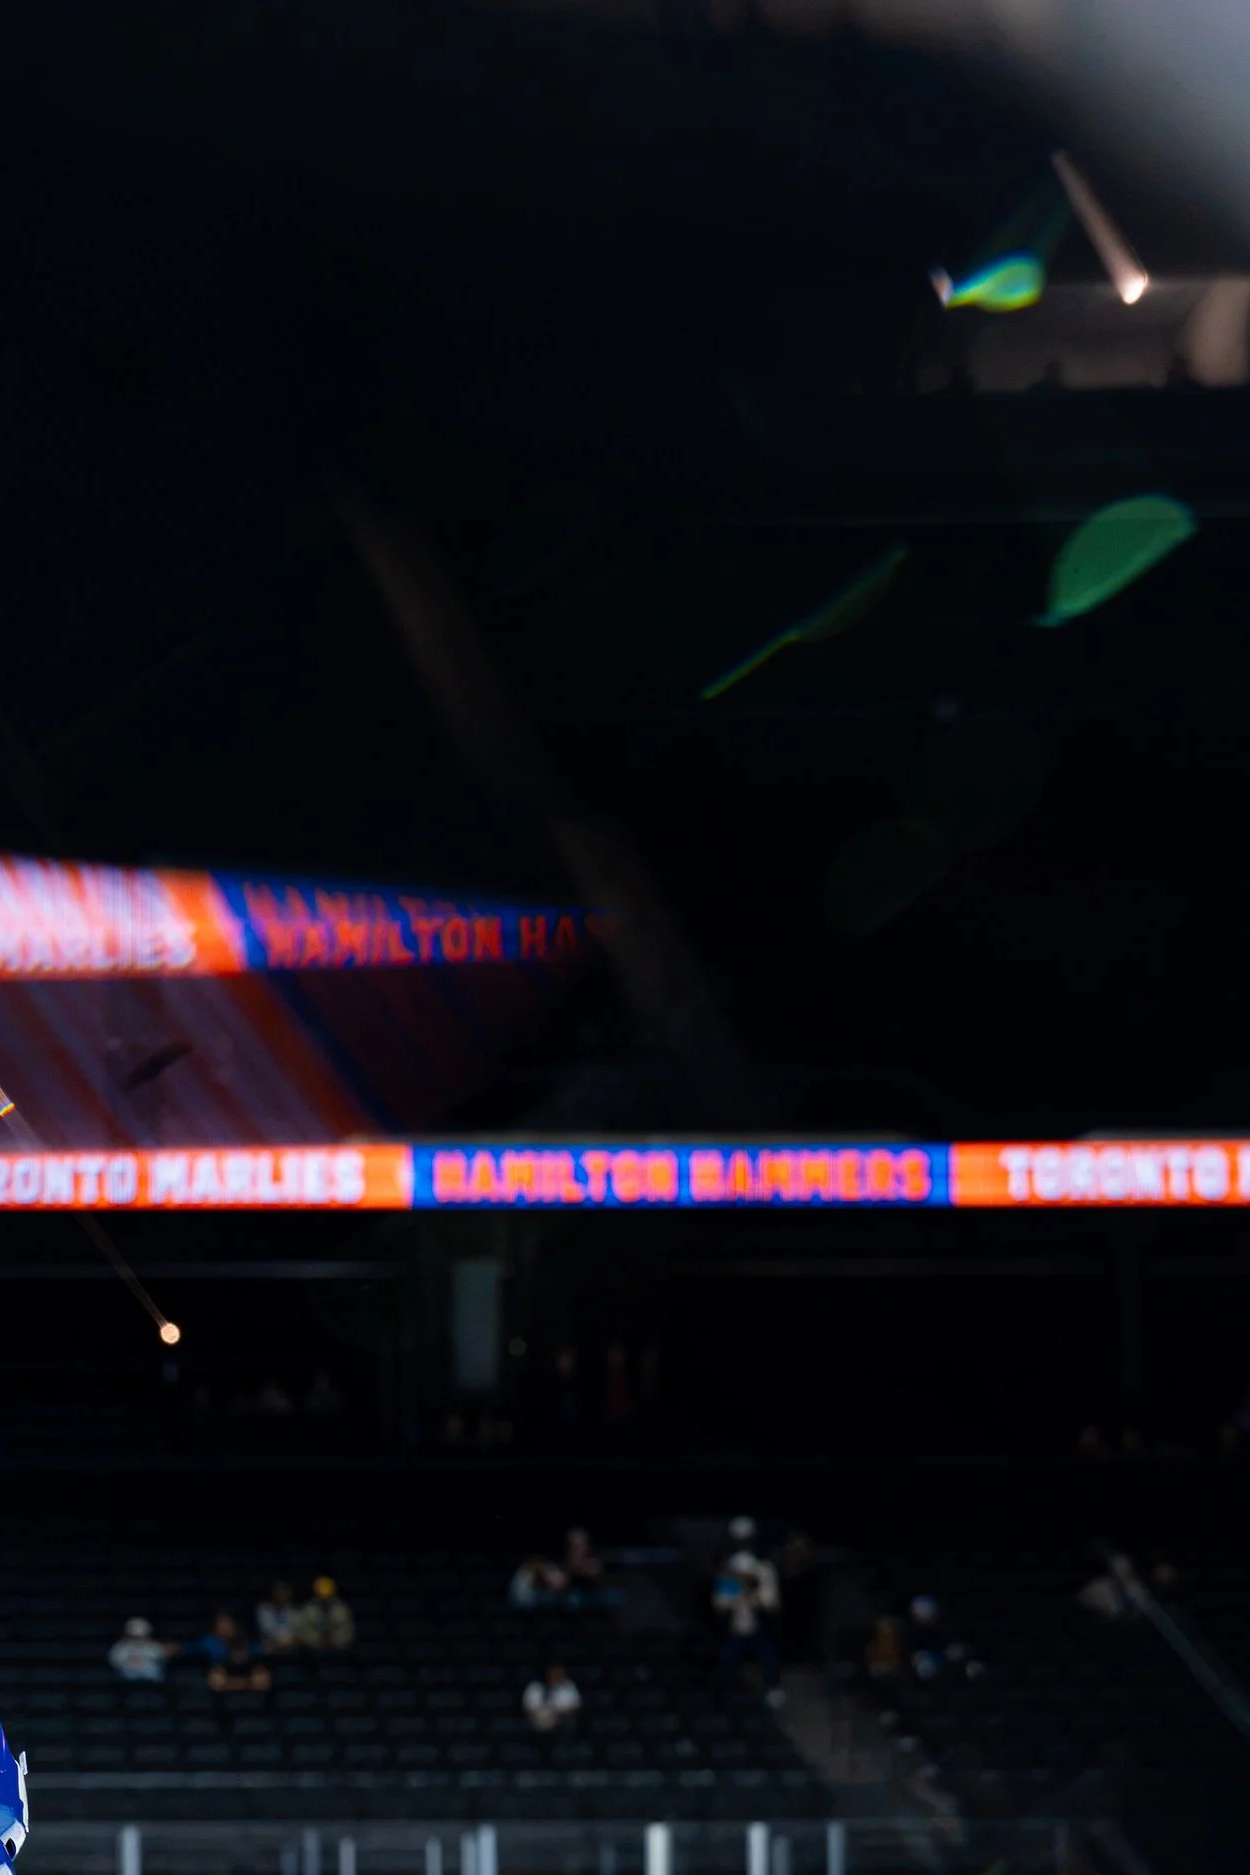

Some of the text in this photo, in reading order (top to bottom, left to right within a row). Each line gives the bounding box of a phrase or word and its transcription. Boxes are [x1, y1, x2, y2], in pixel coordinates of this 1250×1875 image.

[148, 1150, 365, 1205] MARLIES
[433, 1150, 679, 1203] HAMILTON
[999, 1147, 1228, 1202] TORONTO
